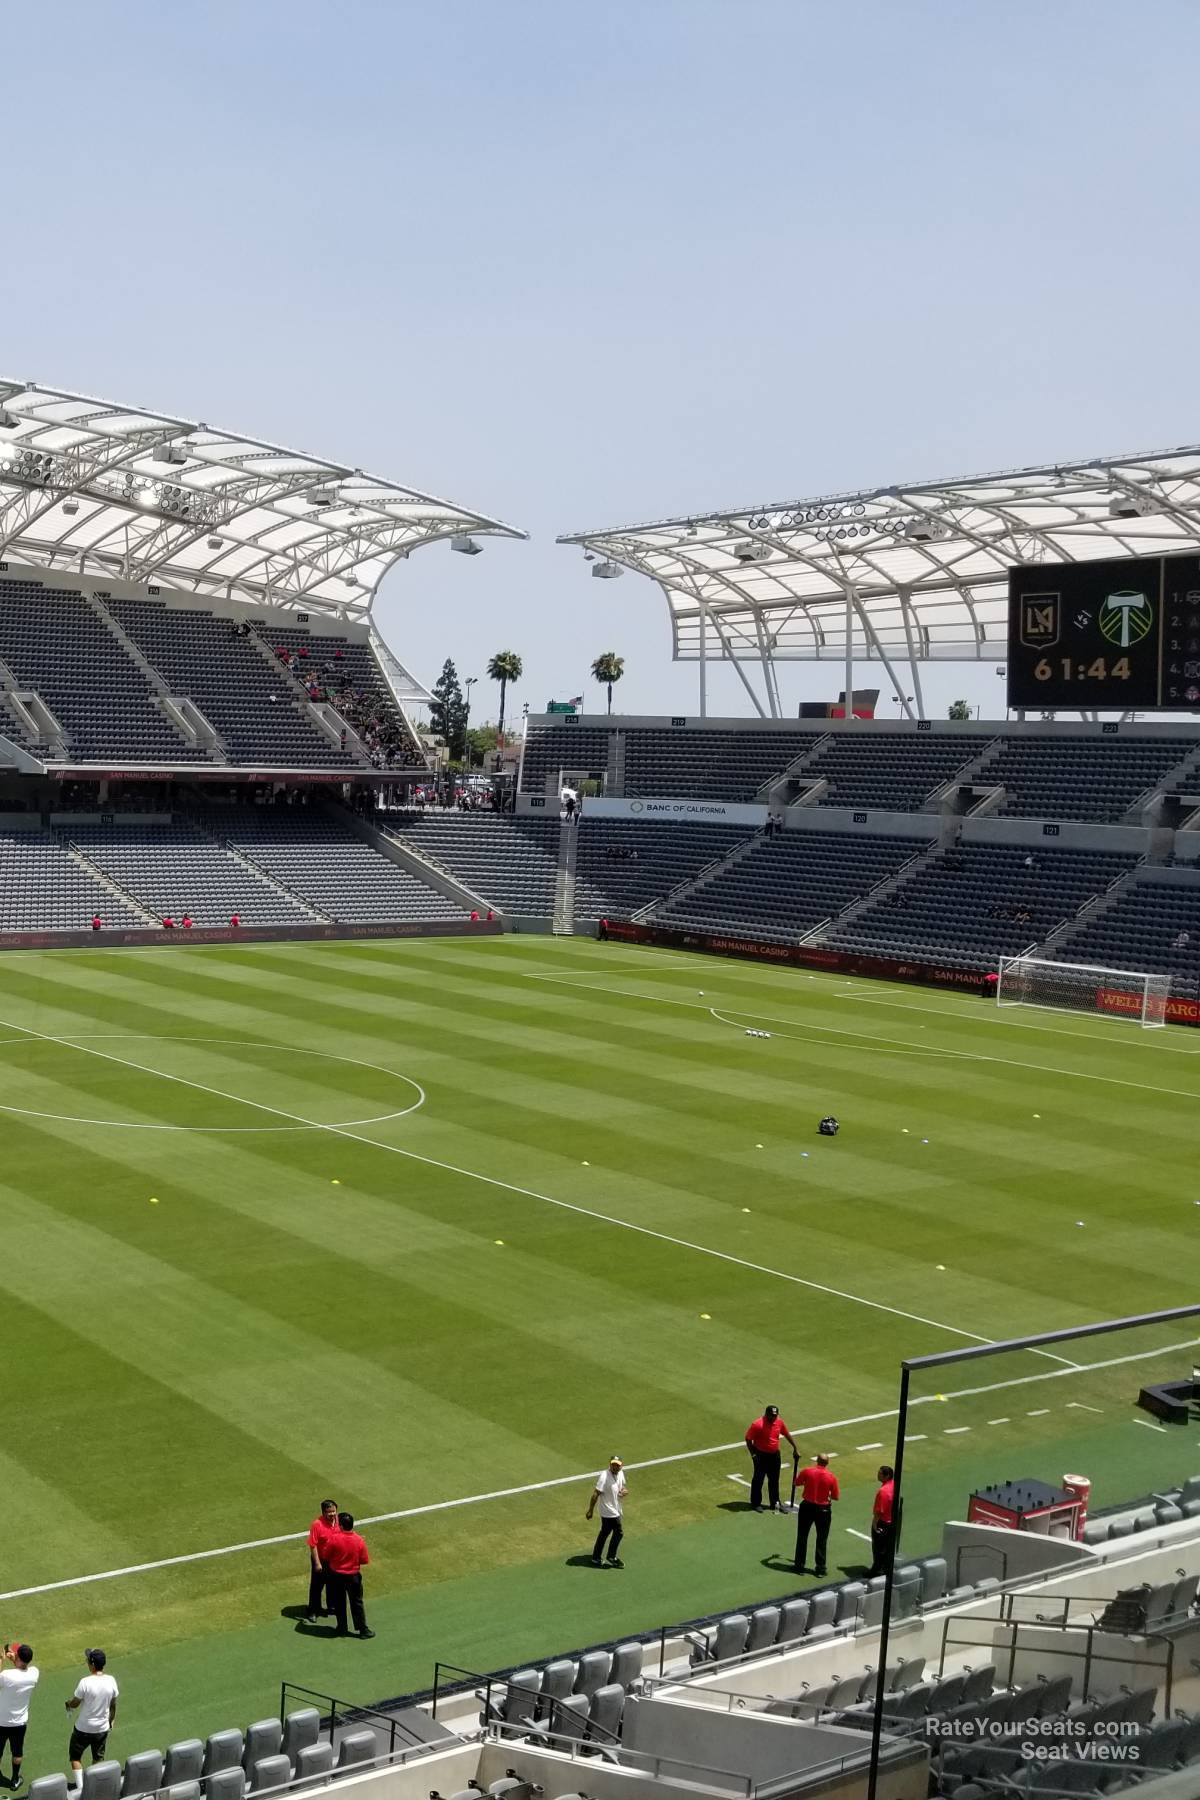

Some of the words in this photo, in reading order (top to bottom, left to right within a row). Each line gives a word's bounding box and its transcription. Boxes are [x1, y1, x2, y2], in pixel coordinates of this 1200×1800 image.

[1171, 617, 1182, 626] 2.
[1171, 640, 1182, 650] 3.
[1034, 657, 1131, 681] 61:44
[1170, 664, 1181, 674] 4.
[1170, 687, 1181, 697] 5.
[673, 718, 686, 726] 219
[918, 721, 930, 730] 220
[1104, 724, 1118, 733] 221
[647, 804, 670, 812] BANC
[686, 806, 726, 815] CALIFORNIA
[854, 814, 867, 823] 120
[1045, 826, 1057, 835] 121
[712, 939, 727, 948] SAN
[729, 942, 758, 953] MANUEL
[760, 946, 789, 957] CASINO
[935, 970, 954, 980] SAN
[956, 973, 984, 984] MANU
[1102, 992, 1153, 1011] WELLS
[1158, 998, 1200, 1017] FARG
